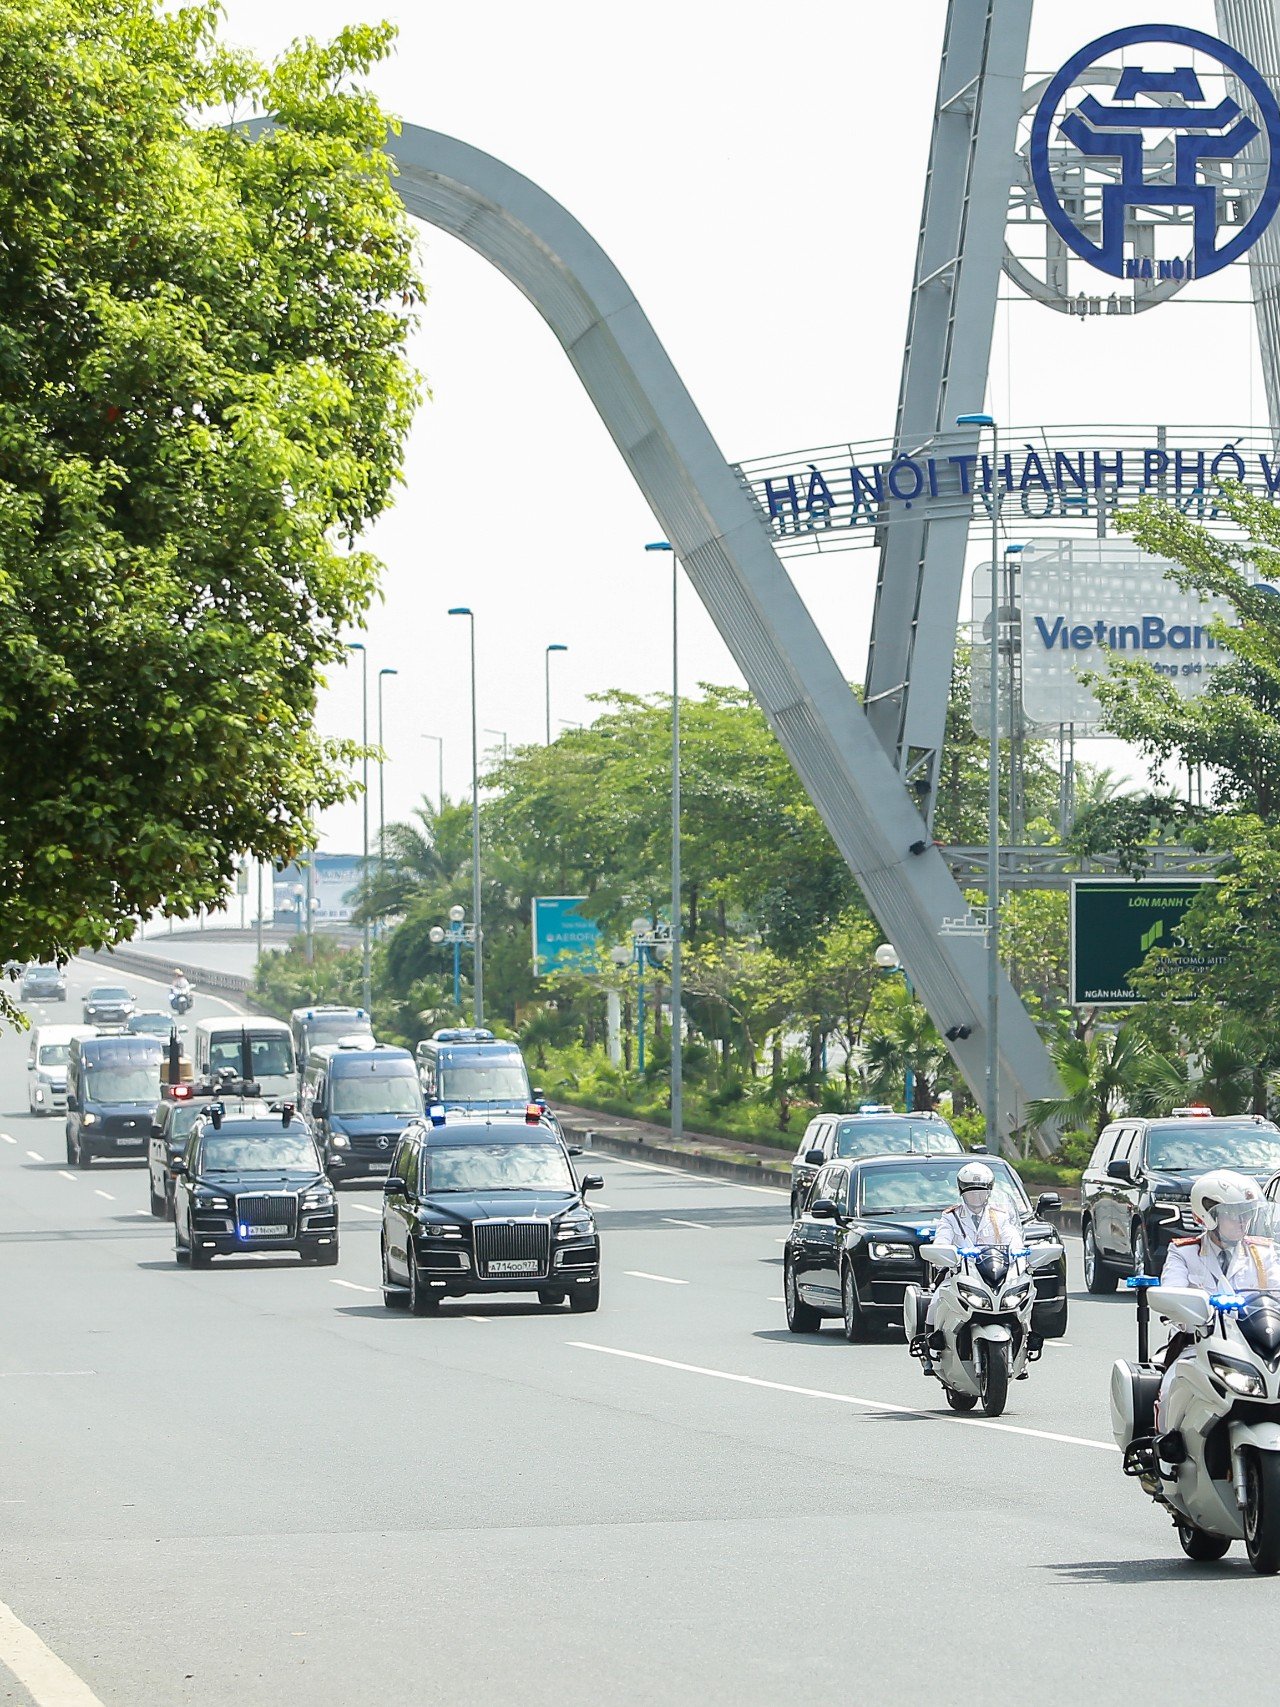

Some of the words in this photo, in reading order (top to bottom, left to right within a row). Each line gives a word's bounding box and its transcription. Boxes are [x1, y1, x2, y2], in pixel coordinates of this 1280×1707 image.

[765, 464, 836, 517] HÀ
[850, 452, 938, 509] NỘI
[948, 444, 1123, 494] THÀNH
[1144, 437, 1246, 489] PHỐ
[1034, 616, 1240, 650] VietinBan
[1085, 988, 1110, 998] NGÂN
